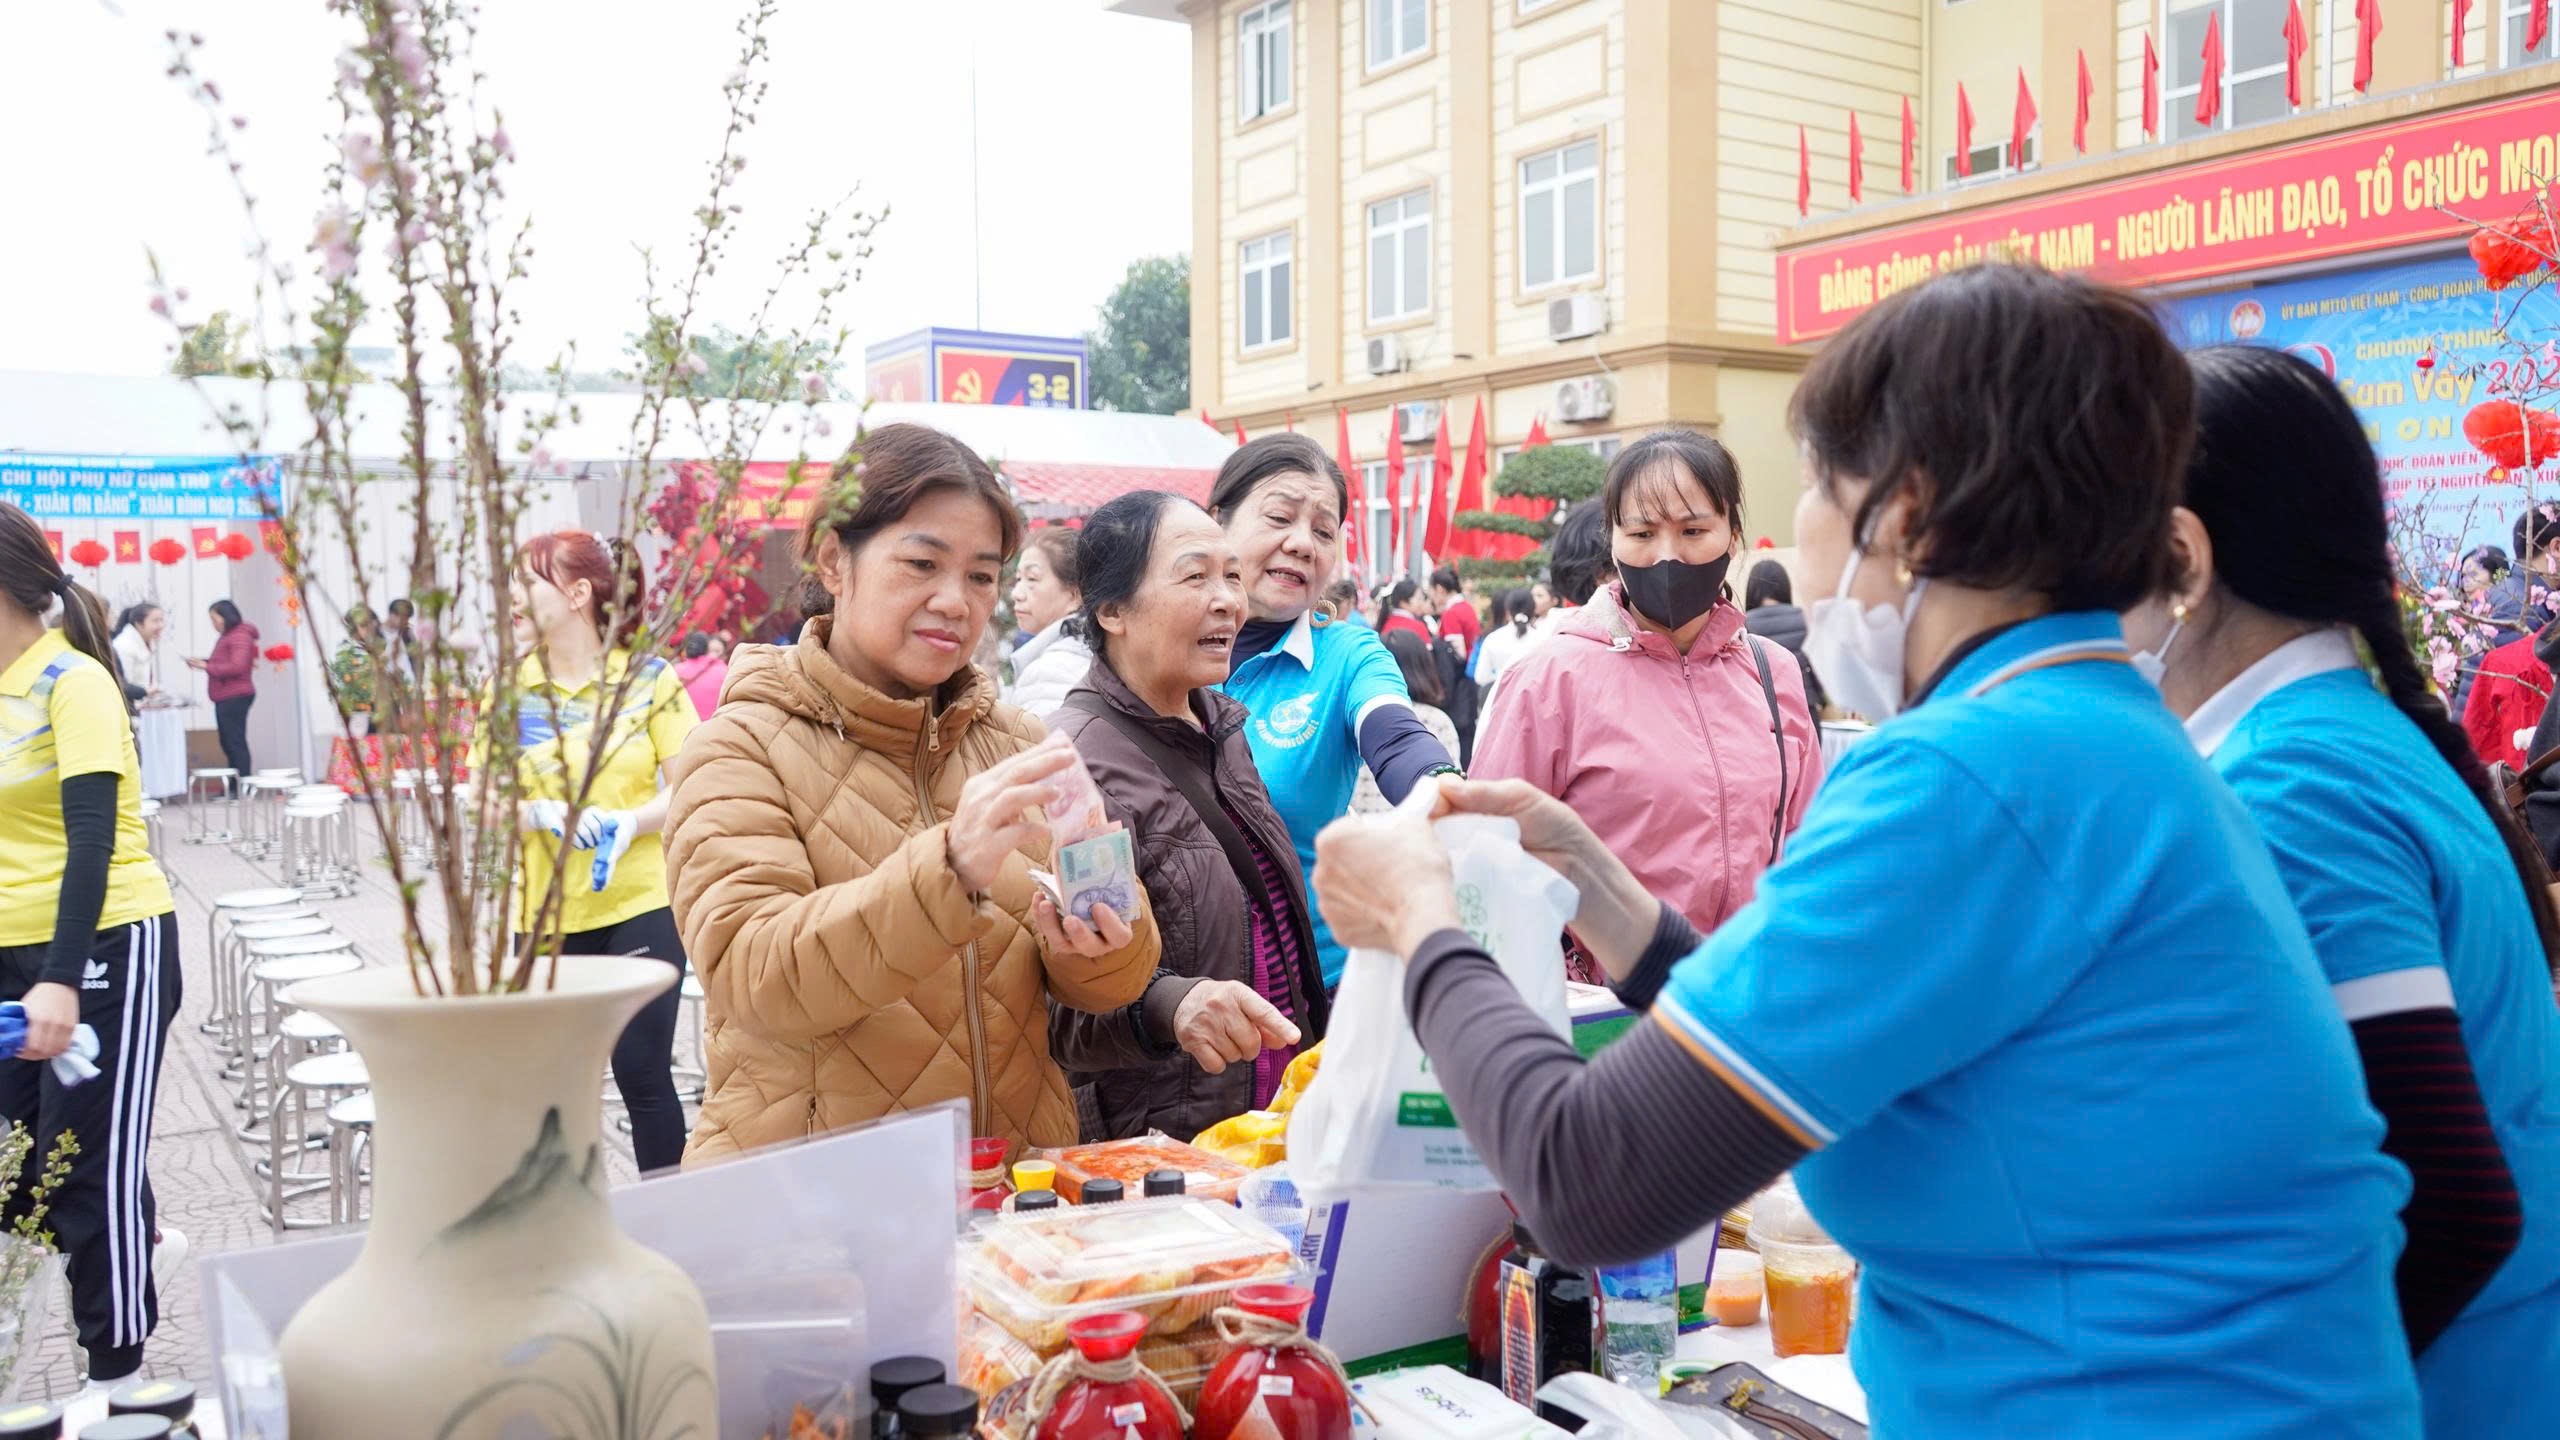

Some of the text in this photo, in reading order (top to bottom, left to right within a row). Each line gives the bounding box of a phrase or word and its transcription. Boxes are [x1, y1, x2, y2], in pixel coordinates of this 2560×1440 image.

[1820, 258, 1874, 313] ĐẢNG
[2039, 223, 2095, 271] NAM
[2117, 195, 2195, 261] NGƯỜI
[2203, 187, 2274, 246] LÃNH
[2281, 175, 2347, 239] ĐẠO,
[2356, 145, 2395, 219] TỔ
[2403, 139, 2489, 211] CHỨC
[2, 469, 32, 487] CHI
[35, 467, 66, 489] HỘI
[69, 470, 105, 490] PHỤ
